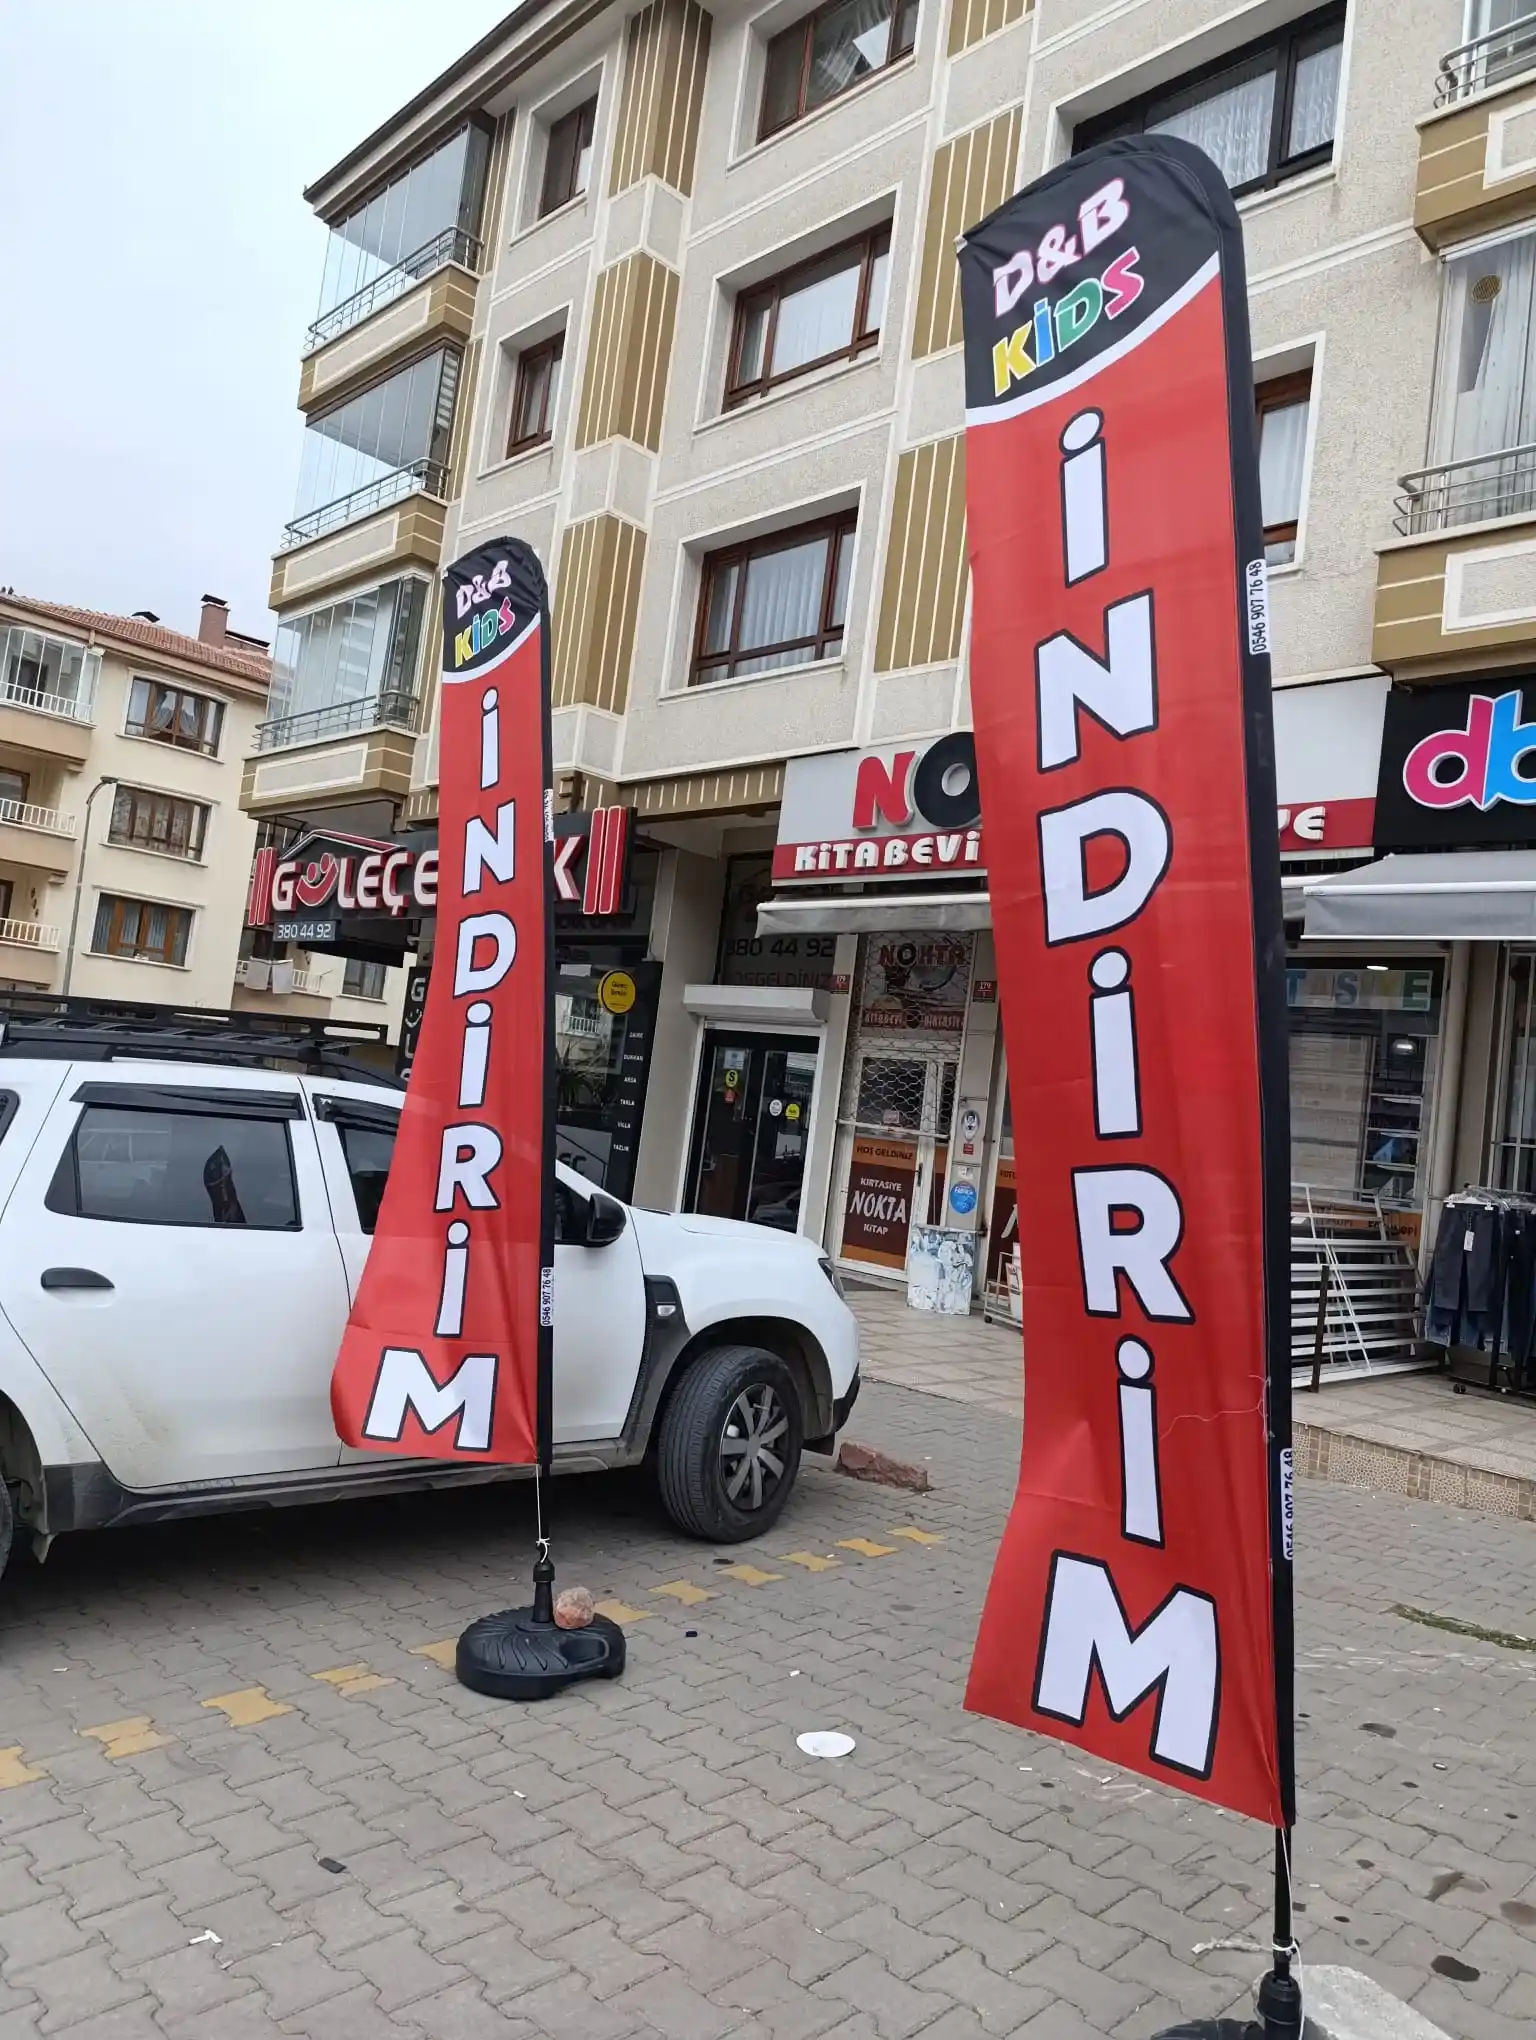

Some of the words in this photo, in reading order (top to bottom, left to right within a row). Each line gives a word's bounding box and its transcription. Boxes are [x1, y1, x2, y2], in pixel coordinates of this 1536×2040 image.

[992, 177, 1130, 319] D&B
[1248, 561, 1262, 577] 48
[456, 560, 512, 620] D&B
[1249, 579, 1264, 595] 76
[1250, 599, 1266, 621] 907
[1251, 622, 1267, 653] 0546
[277, 924, 298, 940] 380
[299, 923, 315, 939] 44
[316, 923, 332, 939] 92
[849, 1190, 908, 1225] NOKTA
